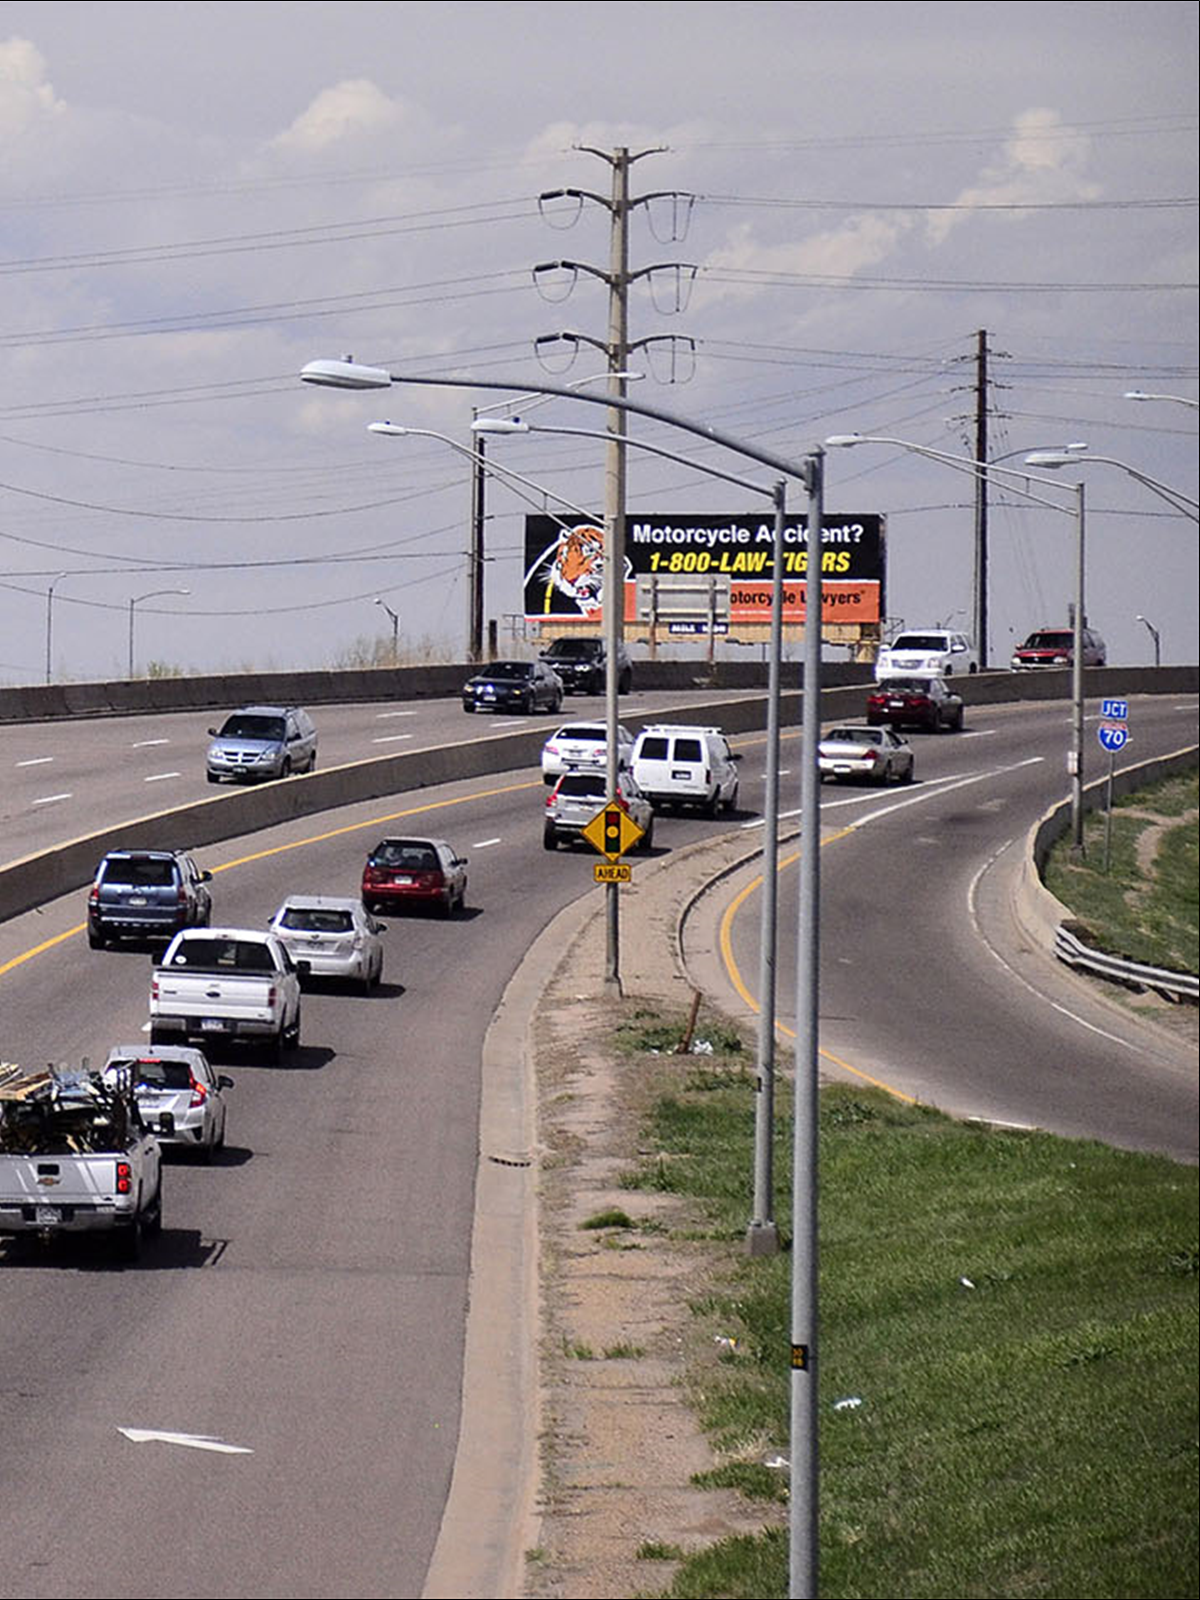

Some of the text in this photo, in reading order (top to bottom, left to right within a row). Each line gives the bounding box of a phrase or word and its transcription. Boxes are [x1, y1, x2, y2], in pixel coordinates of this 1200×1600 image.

[633, 523, 751, 548] Motorcycle
[649, 551, 851, 573] 1-800-LAW-IGRS
[729, 590, 862, 607] otorcyle Lwyers
[1102, 702, 1127, 716] JCT
[1103, 729, 1124, 745] 70
[597, 867, 628, 879] AHEAD
